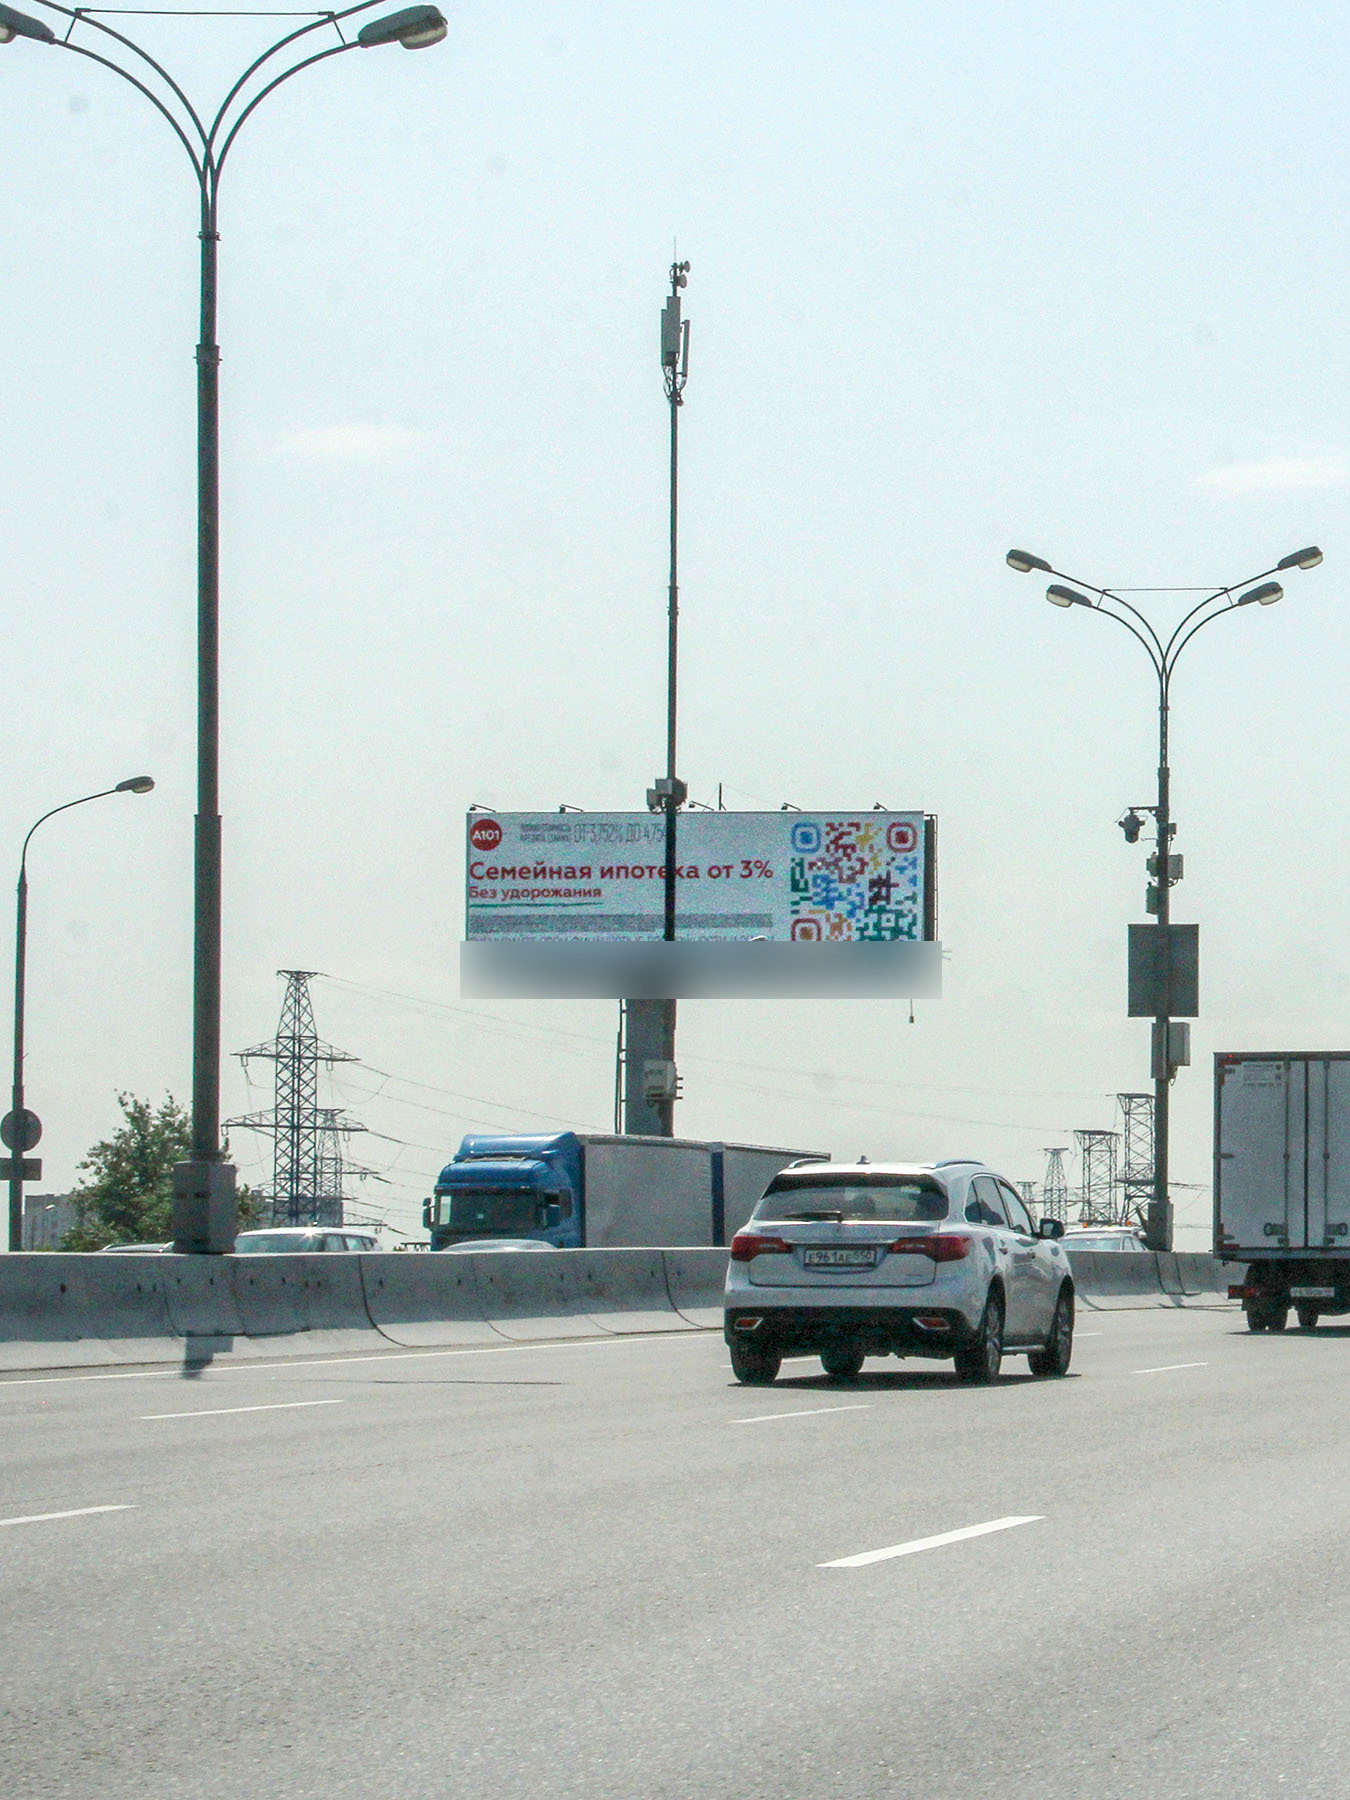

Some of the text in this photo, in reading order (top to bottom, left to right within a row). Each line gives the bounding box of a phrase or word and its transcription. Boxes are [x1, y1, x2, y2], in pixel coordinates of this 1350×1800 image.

[469, 859, 773, 880] Семейная ипотека от 3%
[469, 886, 602, 900] Без удорожания
